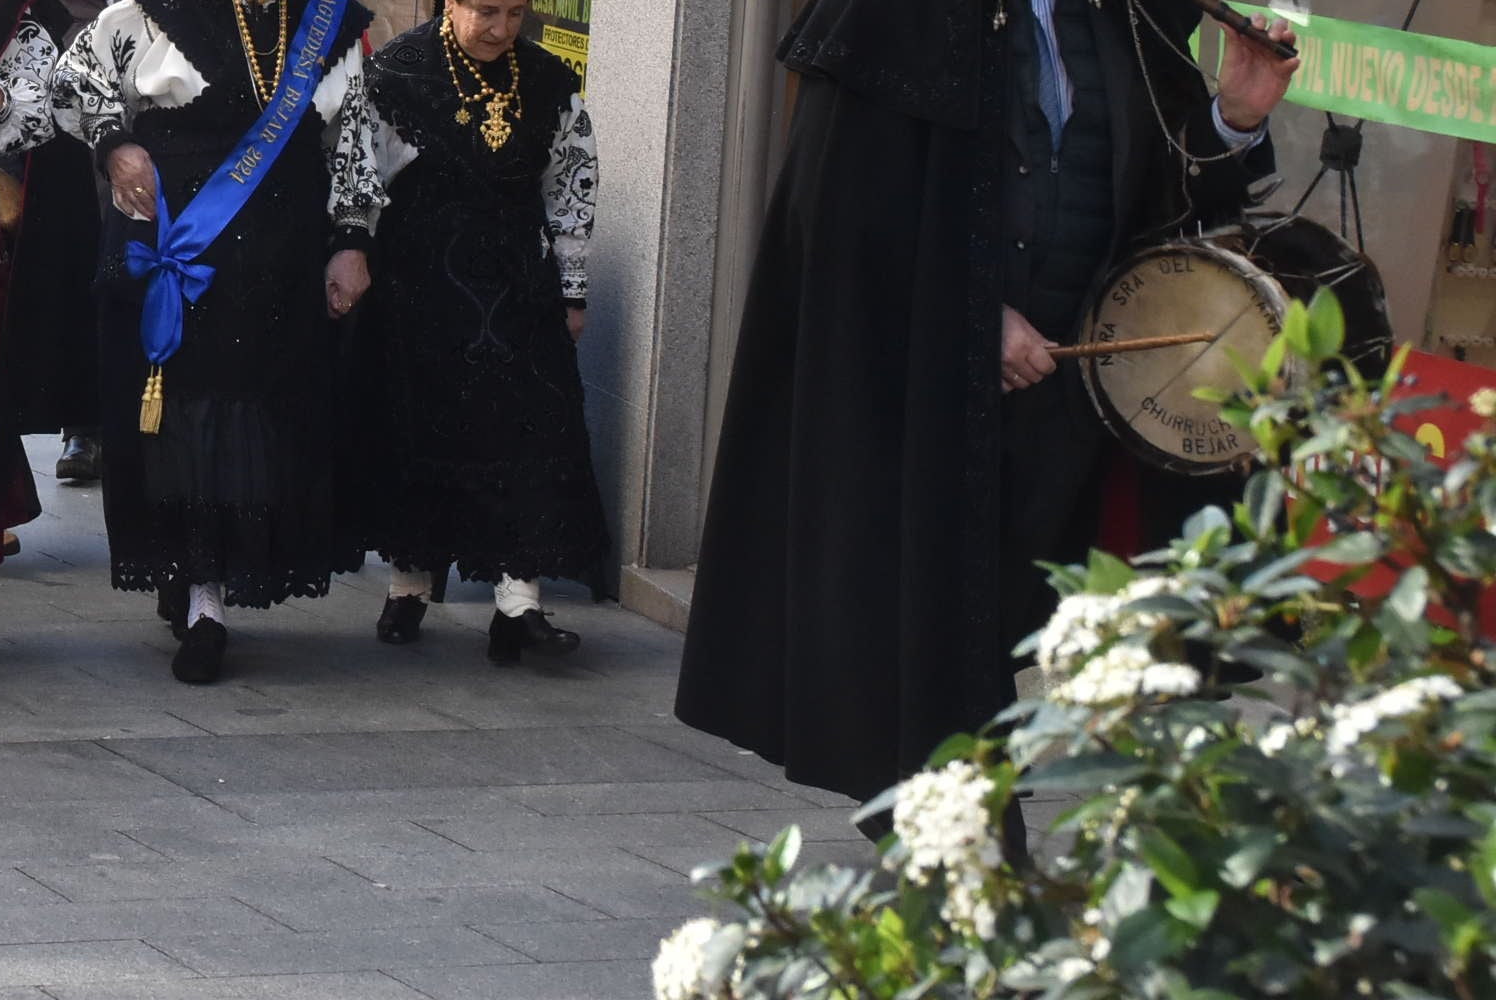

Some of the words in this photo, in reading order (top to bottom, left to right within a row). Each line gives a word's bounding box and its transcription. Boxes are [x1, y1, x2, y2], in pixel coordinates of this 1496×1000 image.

[1329, 41, 1404, 107] NUEVO
[1406, 55, 1484, 124] DESDE
[262, 86, 302, 144] BEJAR
[226, 144, 264, 186] 2024
[1100, 321, 1117, 367] NRA
[1112, 275, 1145, 307] SRA
[1181, 433, 1239, 455] BEJAR
